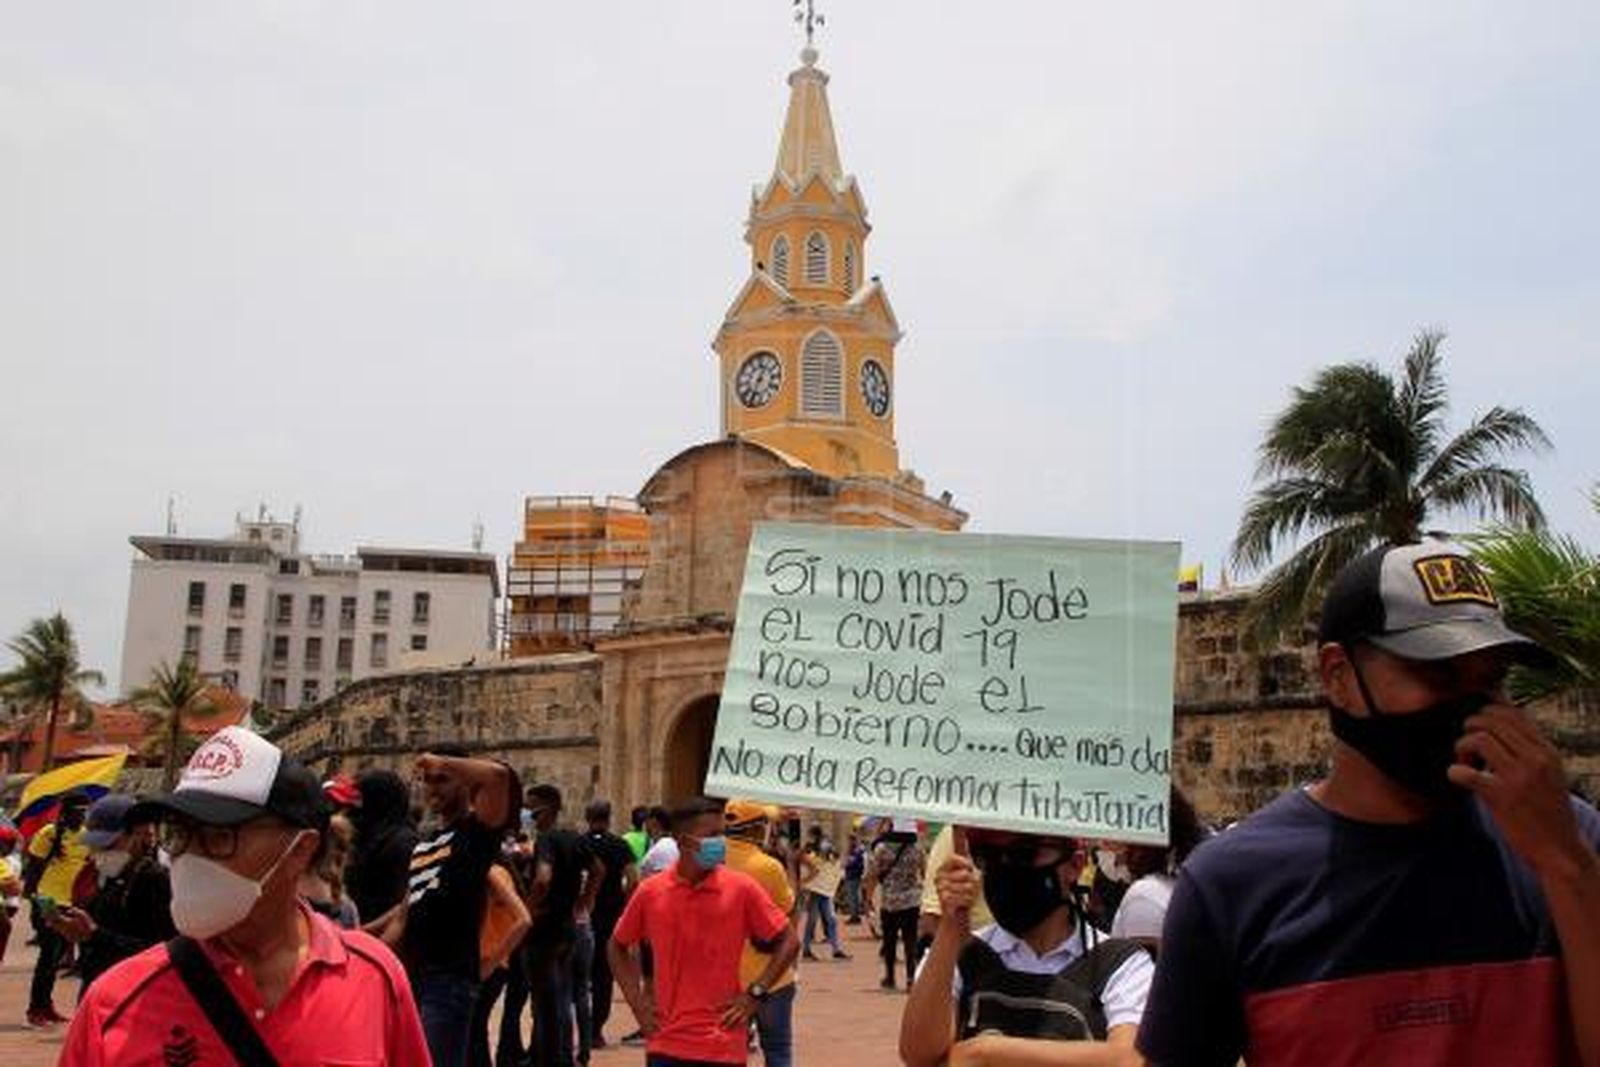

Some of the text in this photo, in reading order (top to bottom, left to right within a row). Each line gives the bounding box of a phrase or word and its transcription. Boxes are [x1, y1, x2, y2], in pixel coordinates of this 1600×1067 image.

[765, 548, 822, 596] Si
[836, 564, 884, 605] no
[898, 567, 969, 607] nos
[757, 650, 831, 690] nos
[963, 628, 1018, 670] 19
[712, 737, 765, 778] No
[1130, 733, 1171, 775] da
